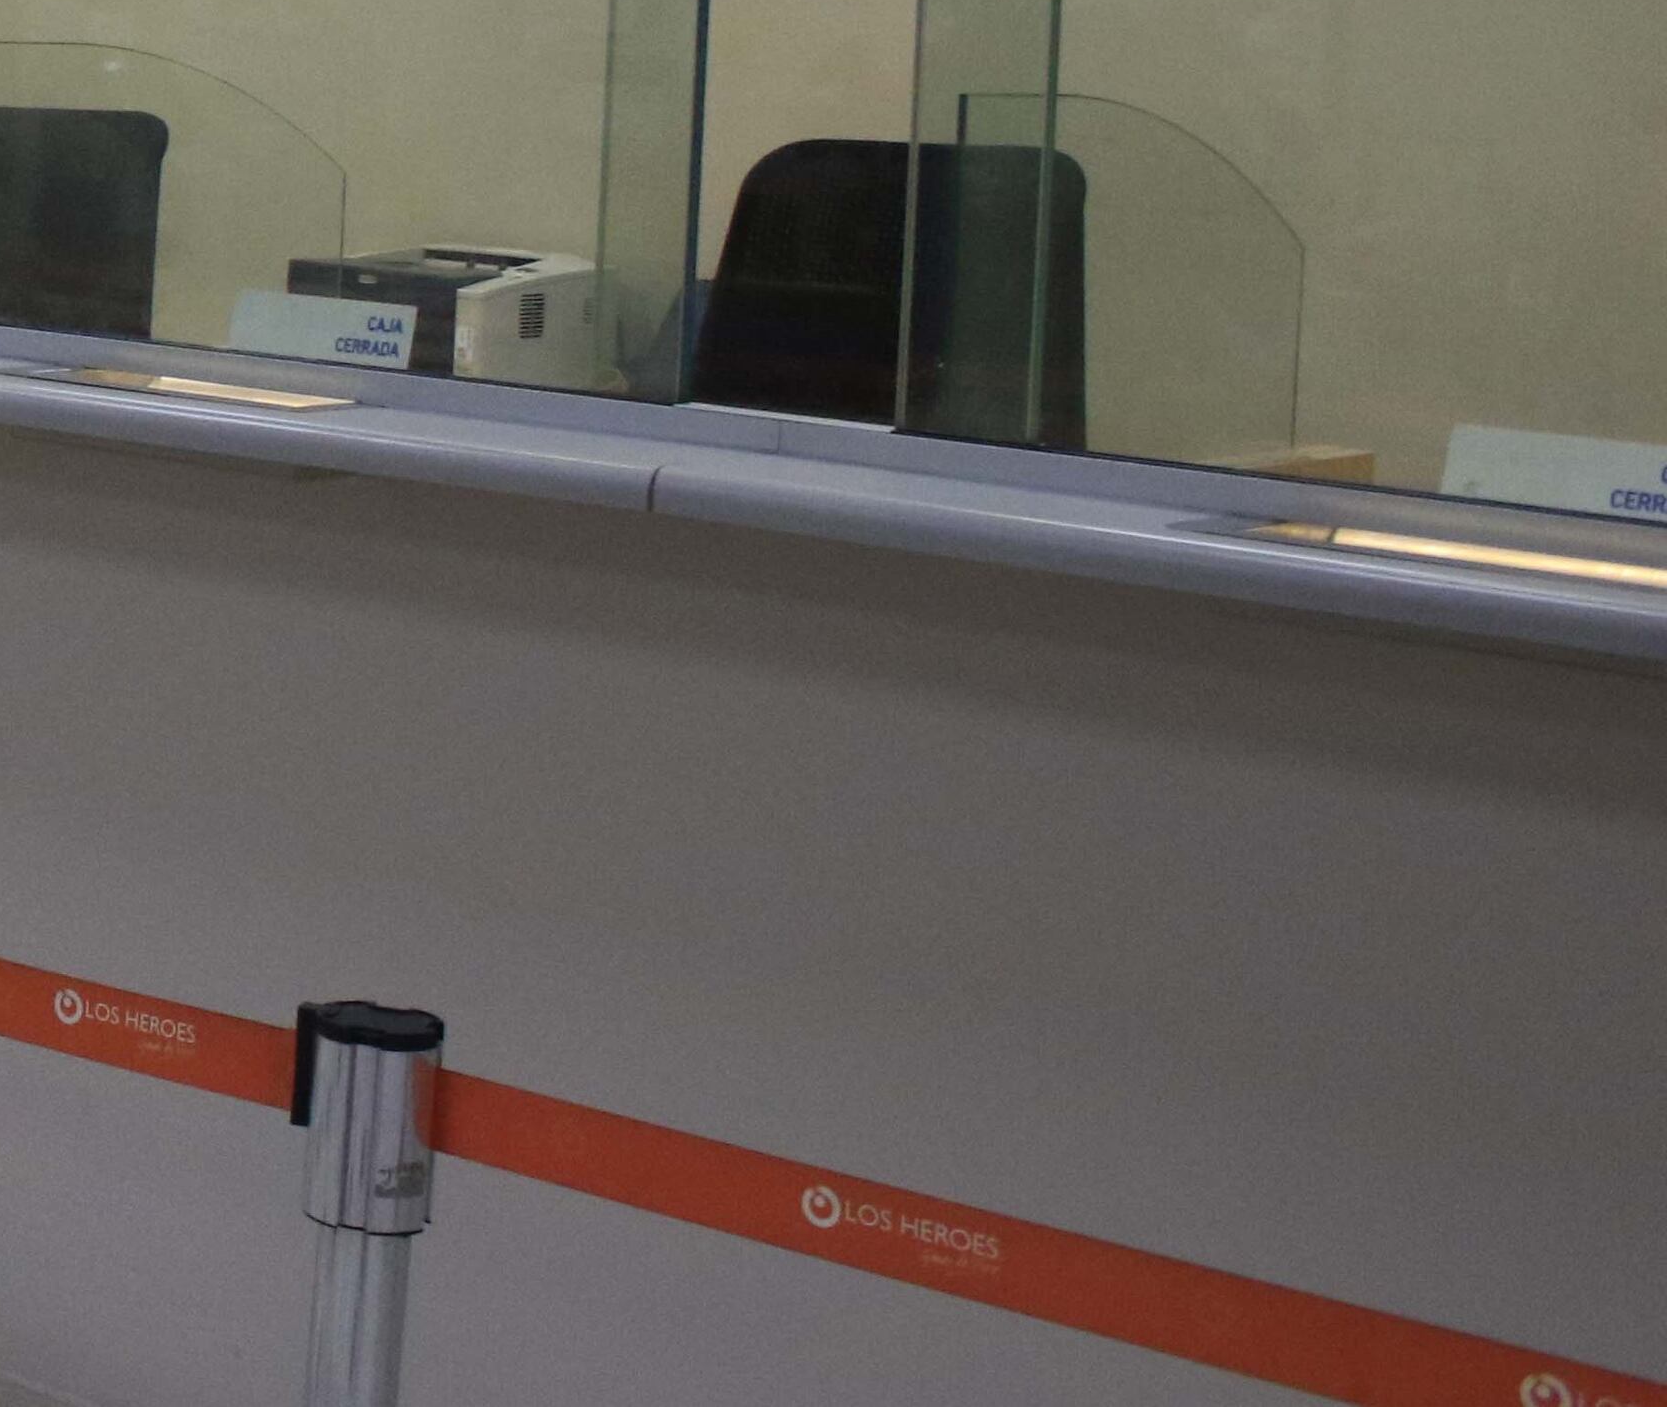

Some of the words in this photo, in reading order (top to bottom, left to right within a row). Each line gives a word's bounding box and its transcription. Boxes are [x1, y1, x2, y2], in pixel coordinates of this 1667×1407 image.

[368, 316, 403, 333] CAJA
[335, 338, 399, 358] CERRADA
[85, 1001, 120, 1025] LOS
[124, 1009, 196, 1043] HEROES
[845, 1200, 892, 1231] LOS
[900, 1214, 1000, 1259] HEROES
